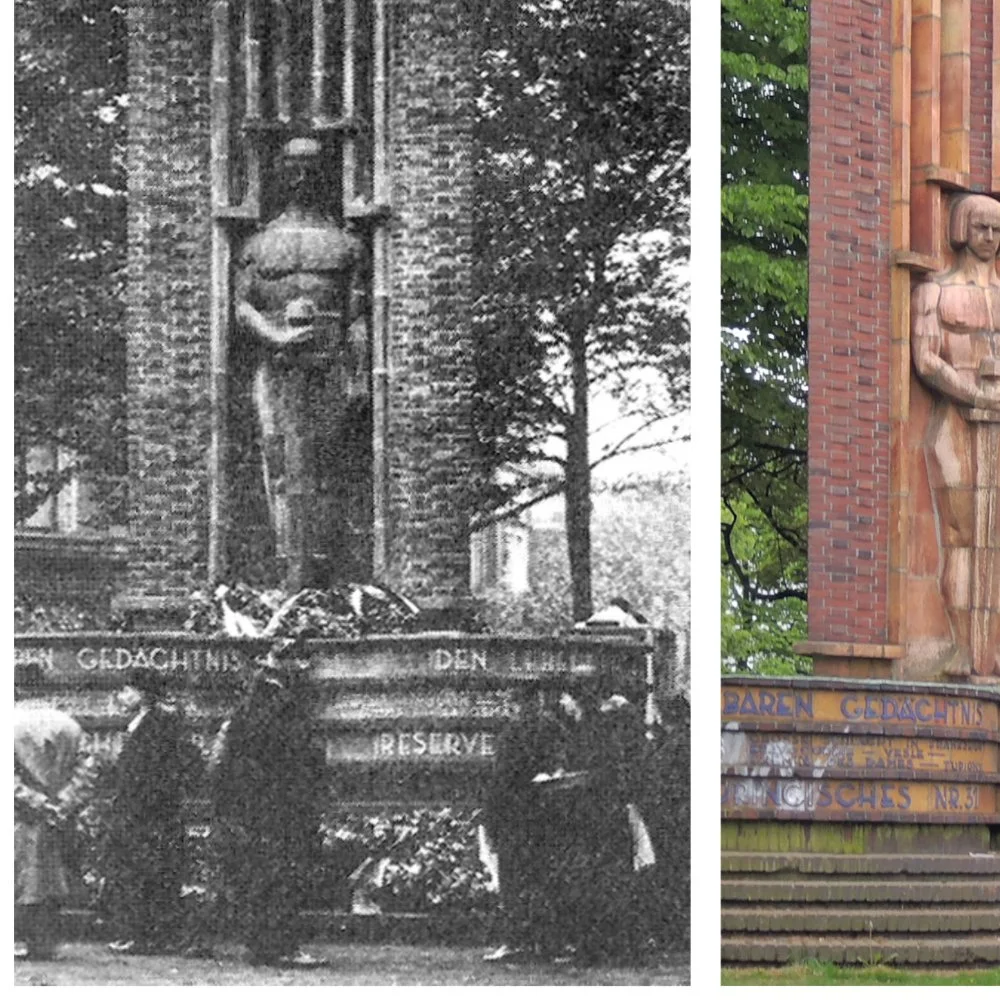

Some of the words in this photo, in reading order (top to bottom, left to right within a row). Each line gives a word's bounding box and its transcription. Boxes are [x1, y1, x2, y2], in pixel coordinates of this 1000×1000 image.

[433, 649, 487, 671] DEN
[723, 690, 813, 718] BAREN
[378, 731, 496, 756] RESERVE
